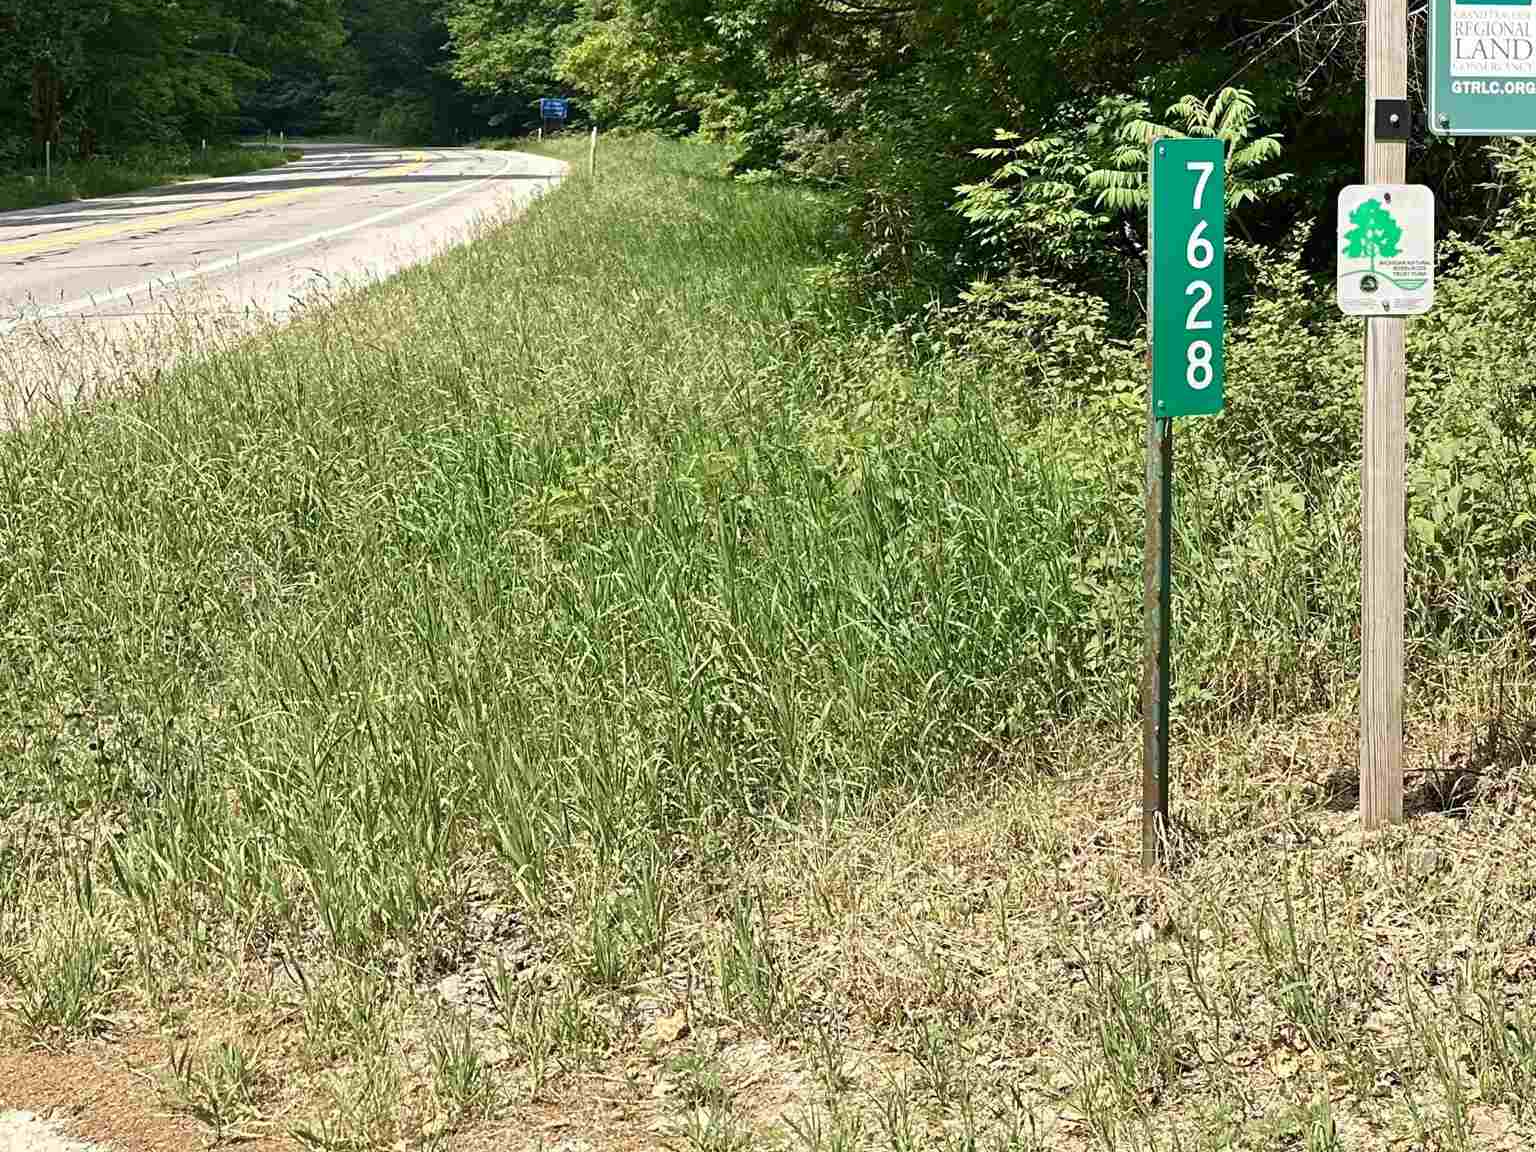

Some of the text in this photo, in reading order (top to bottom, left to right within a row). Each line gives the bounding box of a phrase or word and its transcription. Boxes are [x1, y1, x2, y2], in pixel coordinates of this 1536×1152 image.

[1455, 21, 1532, 37] REGIONAL
[1455, 38, 1534, 60] LAND
[1451, 80, 1536, 95] GTRLC.ORG
[1186, 162, 1214, 390] 7628
